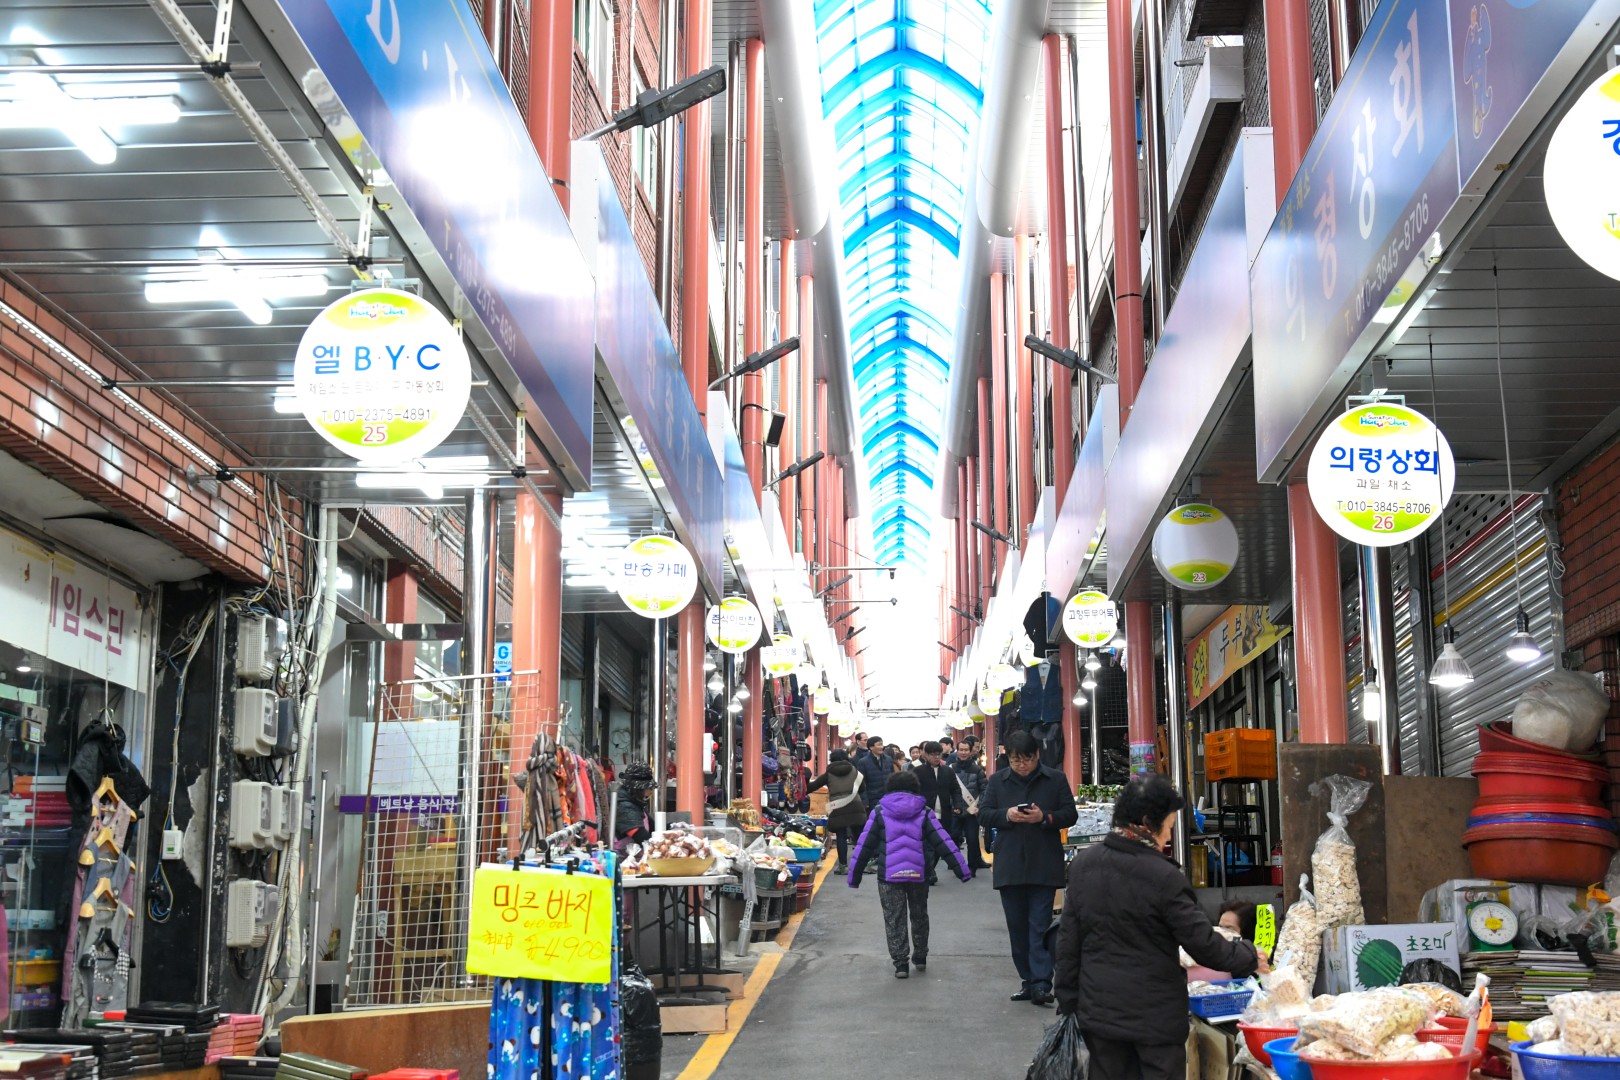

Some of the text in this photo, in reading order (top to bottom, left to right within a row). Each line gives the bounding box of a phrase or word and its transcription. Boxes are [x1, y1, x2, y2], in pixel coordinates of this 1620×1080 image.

[1355, 193, 1429, 321] 010-3845-8706
[312, 345, 340, 374] 엘
[322, 408, 431, 422] T.010-2375-4891
[363, 426, 386, 442] 25
[1330, 446, 1438, 475] 의령상회
[1337, 500, 1431, 514] T.010-3845-8706
[1373, 515, 1393, 530] 26
[624, 563, 687, 577] 반송카페
[1193, 573, 1206, 582] 23
[381, 798, 414, 810] 베트남
[418, 798, 440, 810] 음식
[494, 884, 592, 934] 밍크 바지
